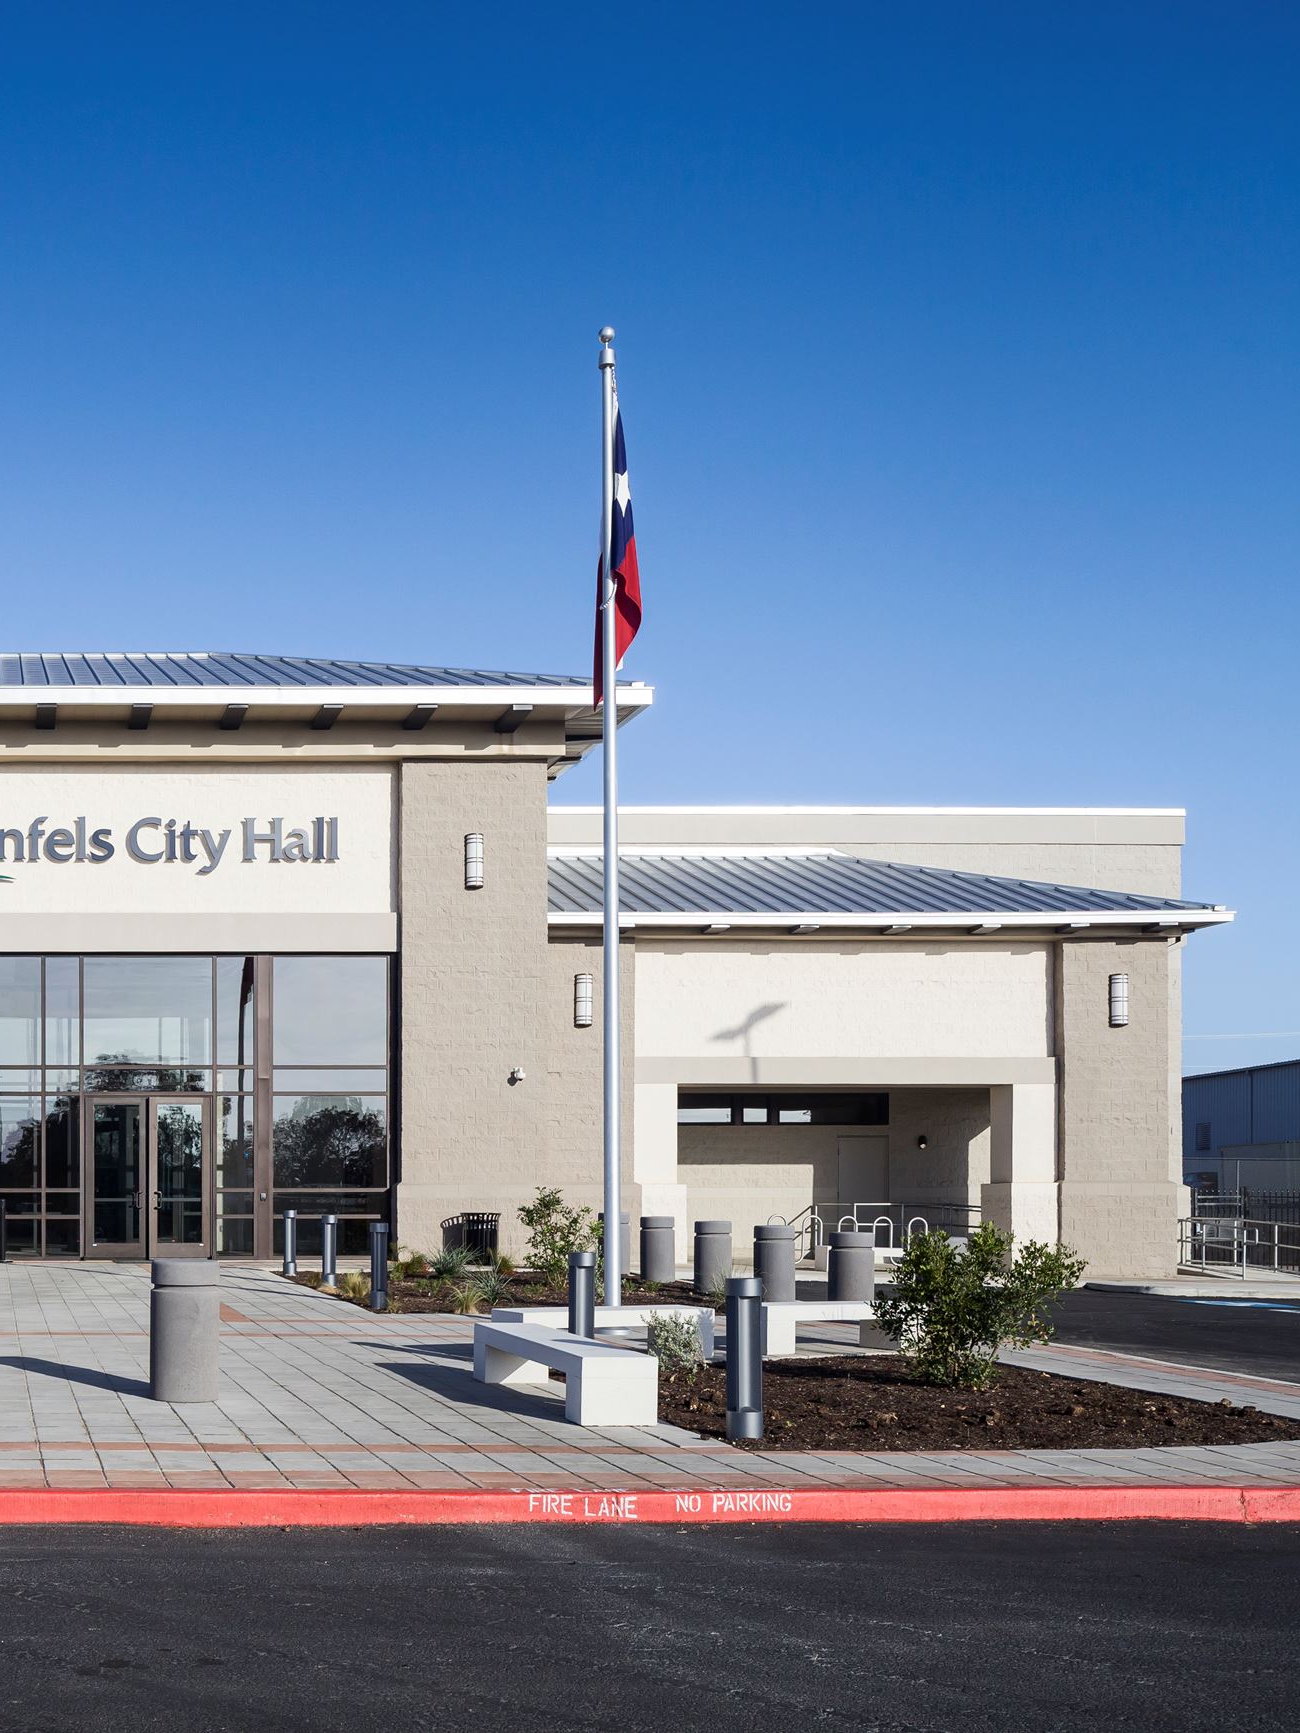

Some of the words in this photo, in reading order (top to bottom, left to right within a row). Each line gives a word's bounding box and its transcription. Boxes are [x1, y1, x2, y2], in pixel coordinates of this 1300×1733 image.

[125, 815, 232, 876] City
[241, 815, 341, 863] Hall
[528, 1493, 574, 1516] FIRE
[584, 1495, 638, 1519] LANE
[675, 1494, 702, 1513] NO
[712, 1493, 792, 1513] PARKING
